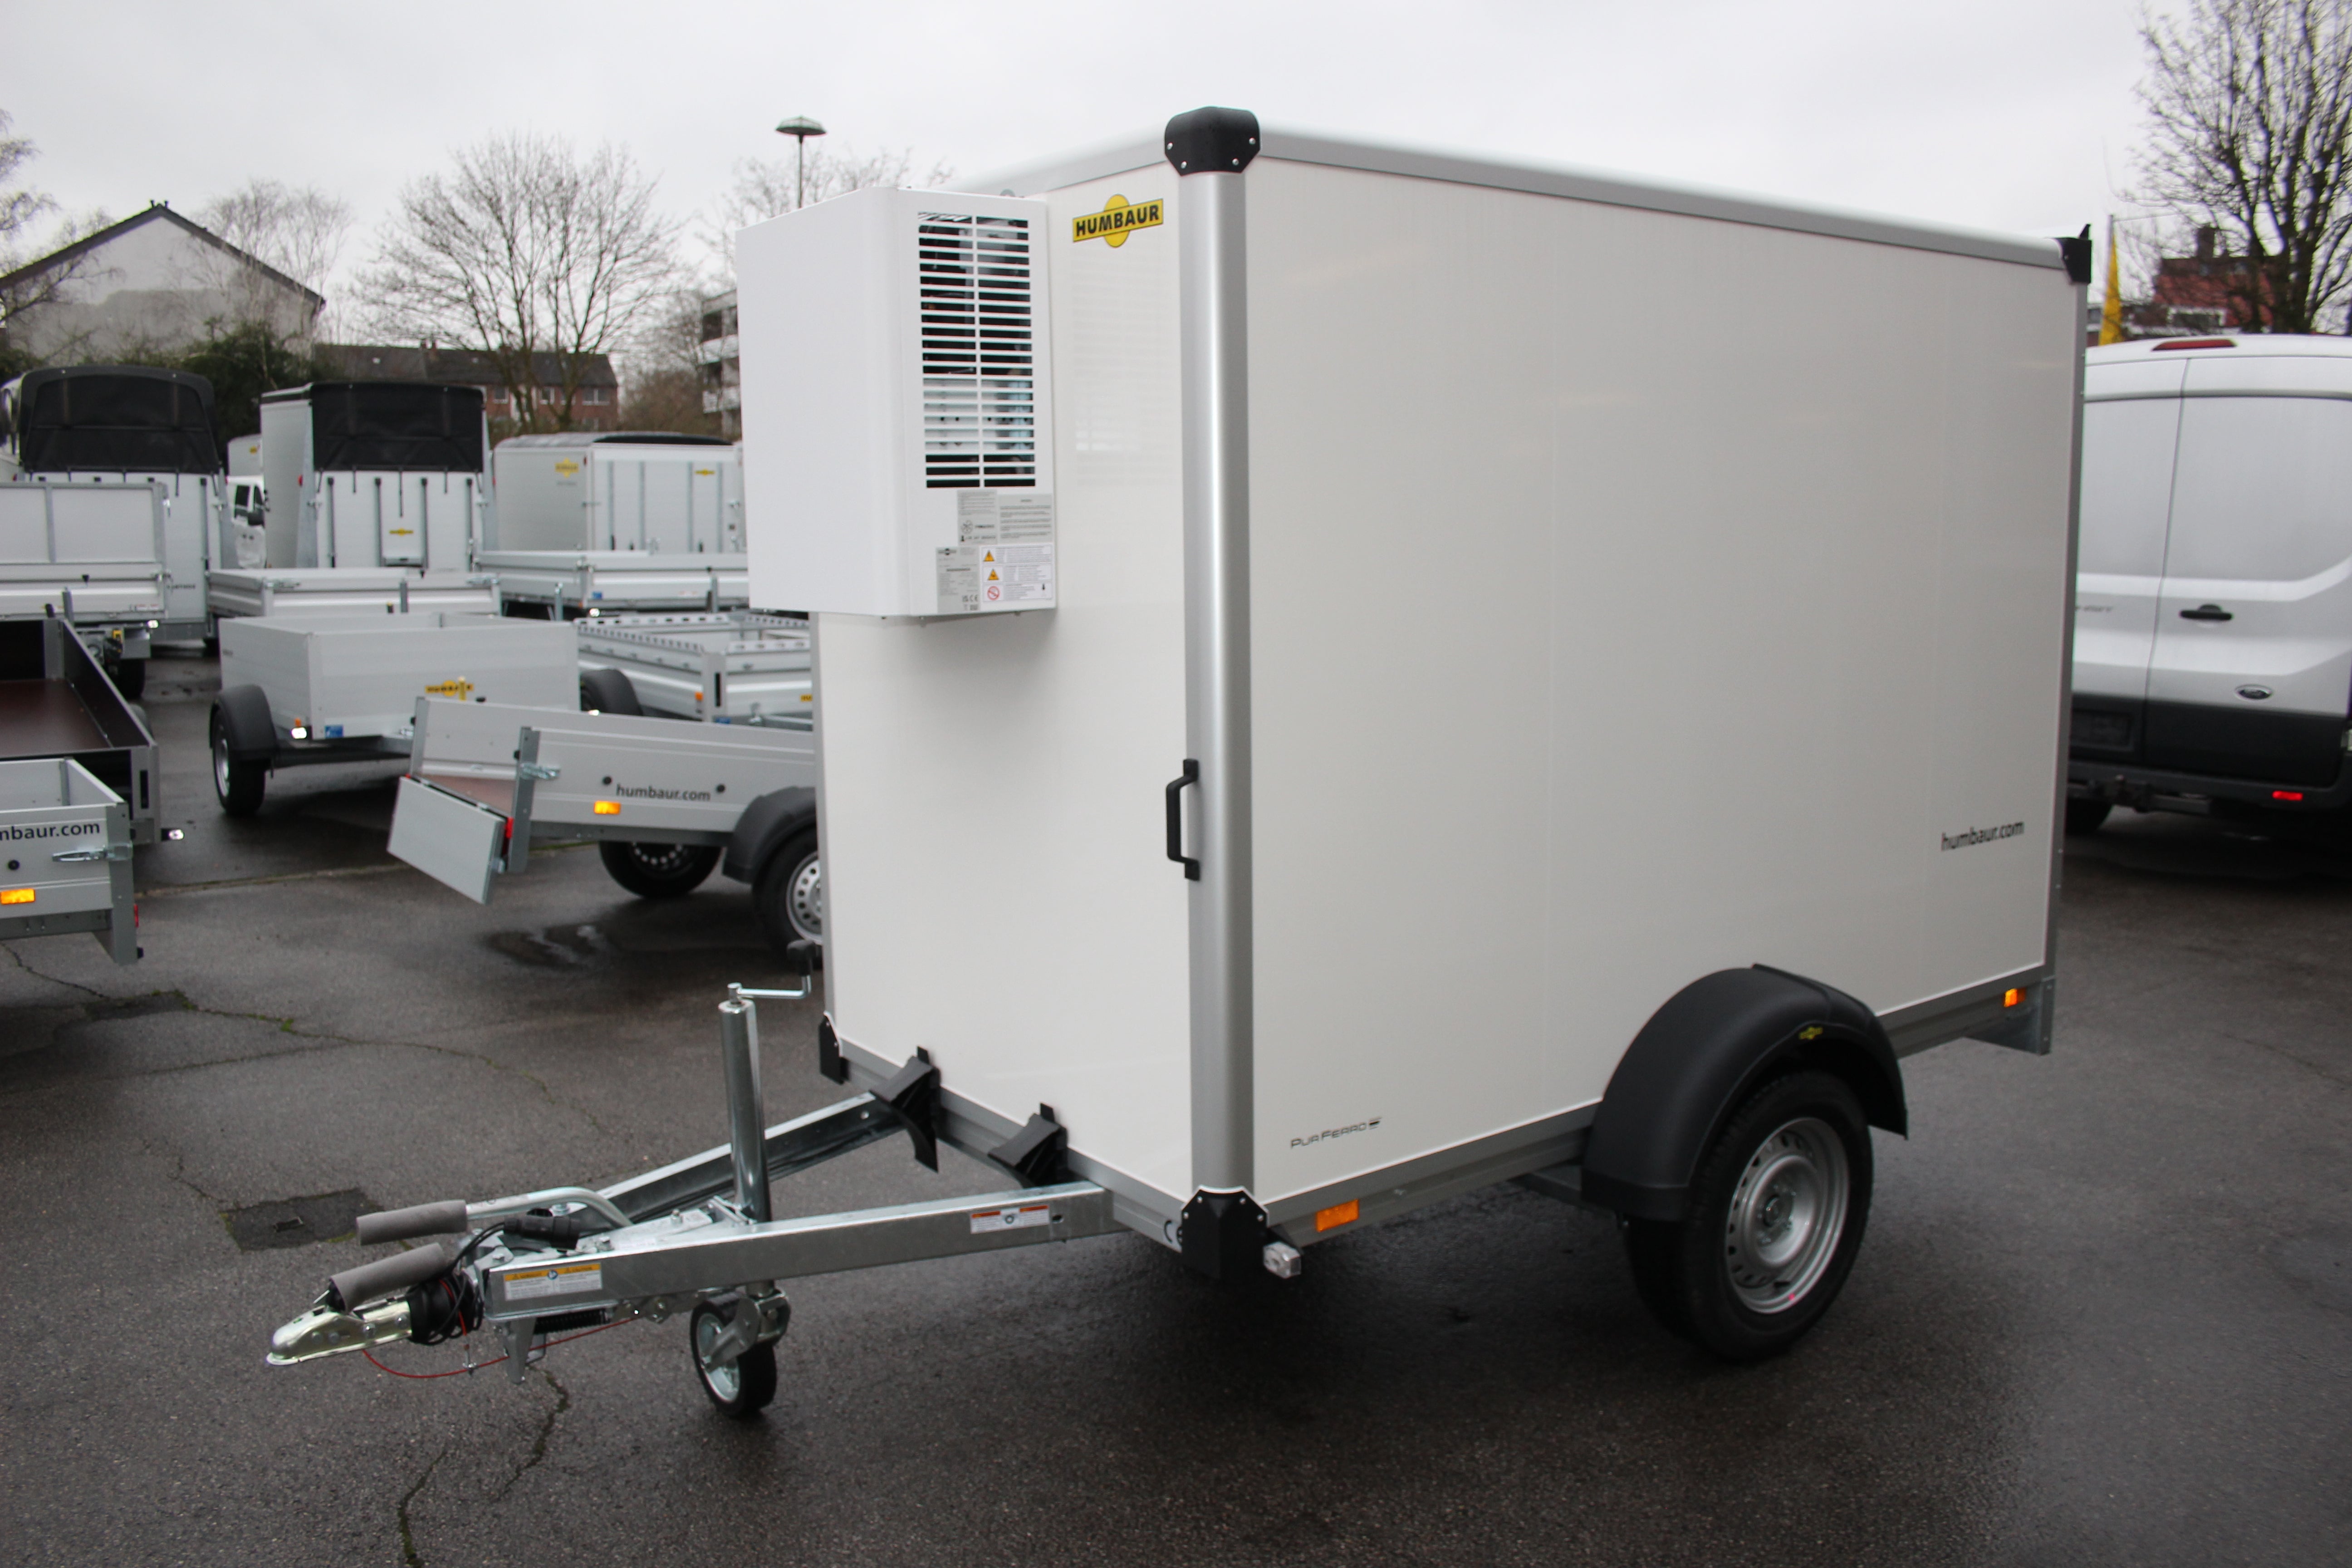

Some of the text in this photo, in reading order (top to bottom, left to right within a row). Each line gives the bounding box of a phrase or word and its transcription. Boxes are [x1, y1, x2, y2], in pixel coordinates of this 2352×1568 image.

[1076, 205, 1159, 236] HUMBAUR
[616, 783, 711, 801] humbaur.com
[1940, 822, 2025, 851] humbaur.com
